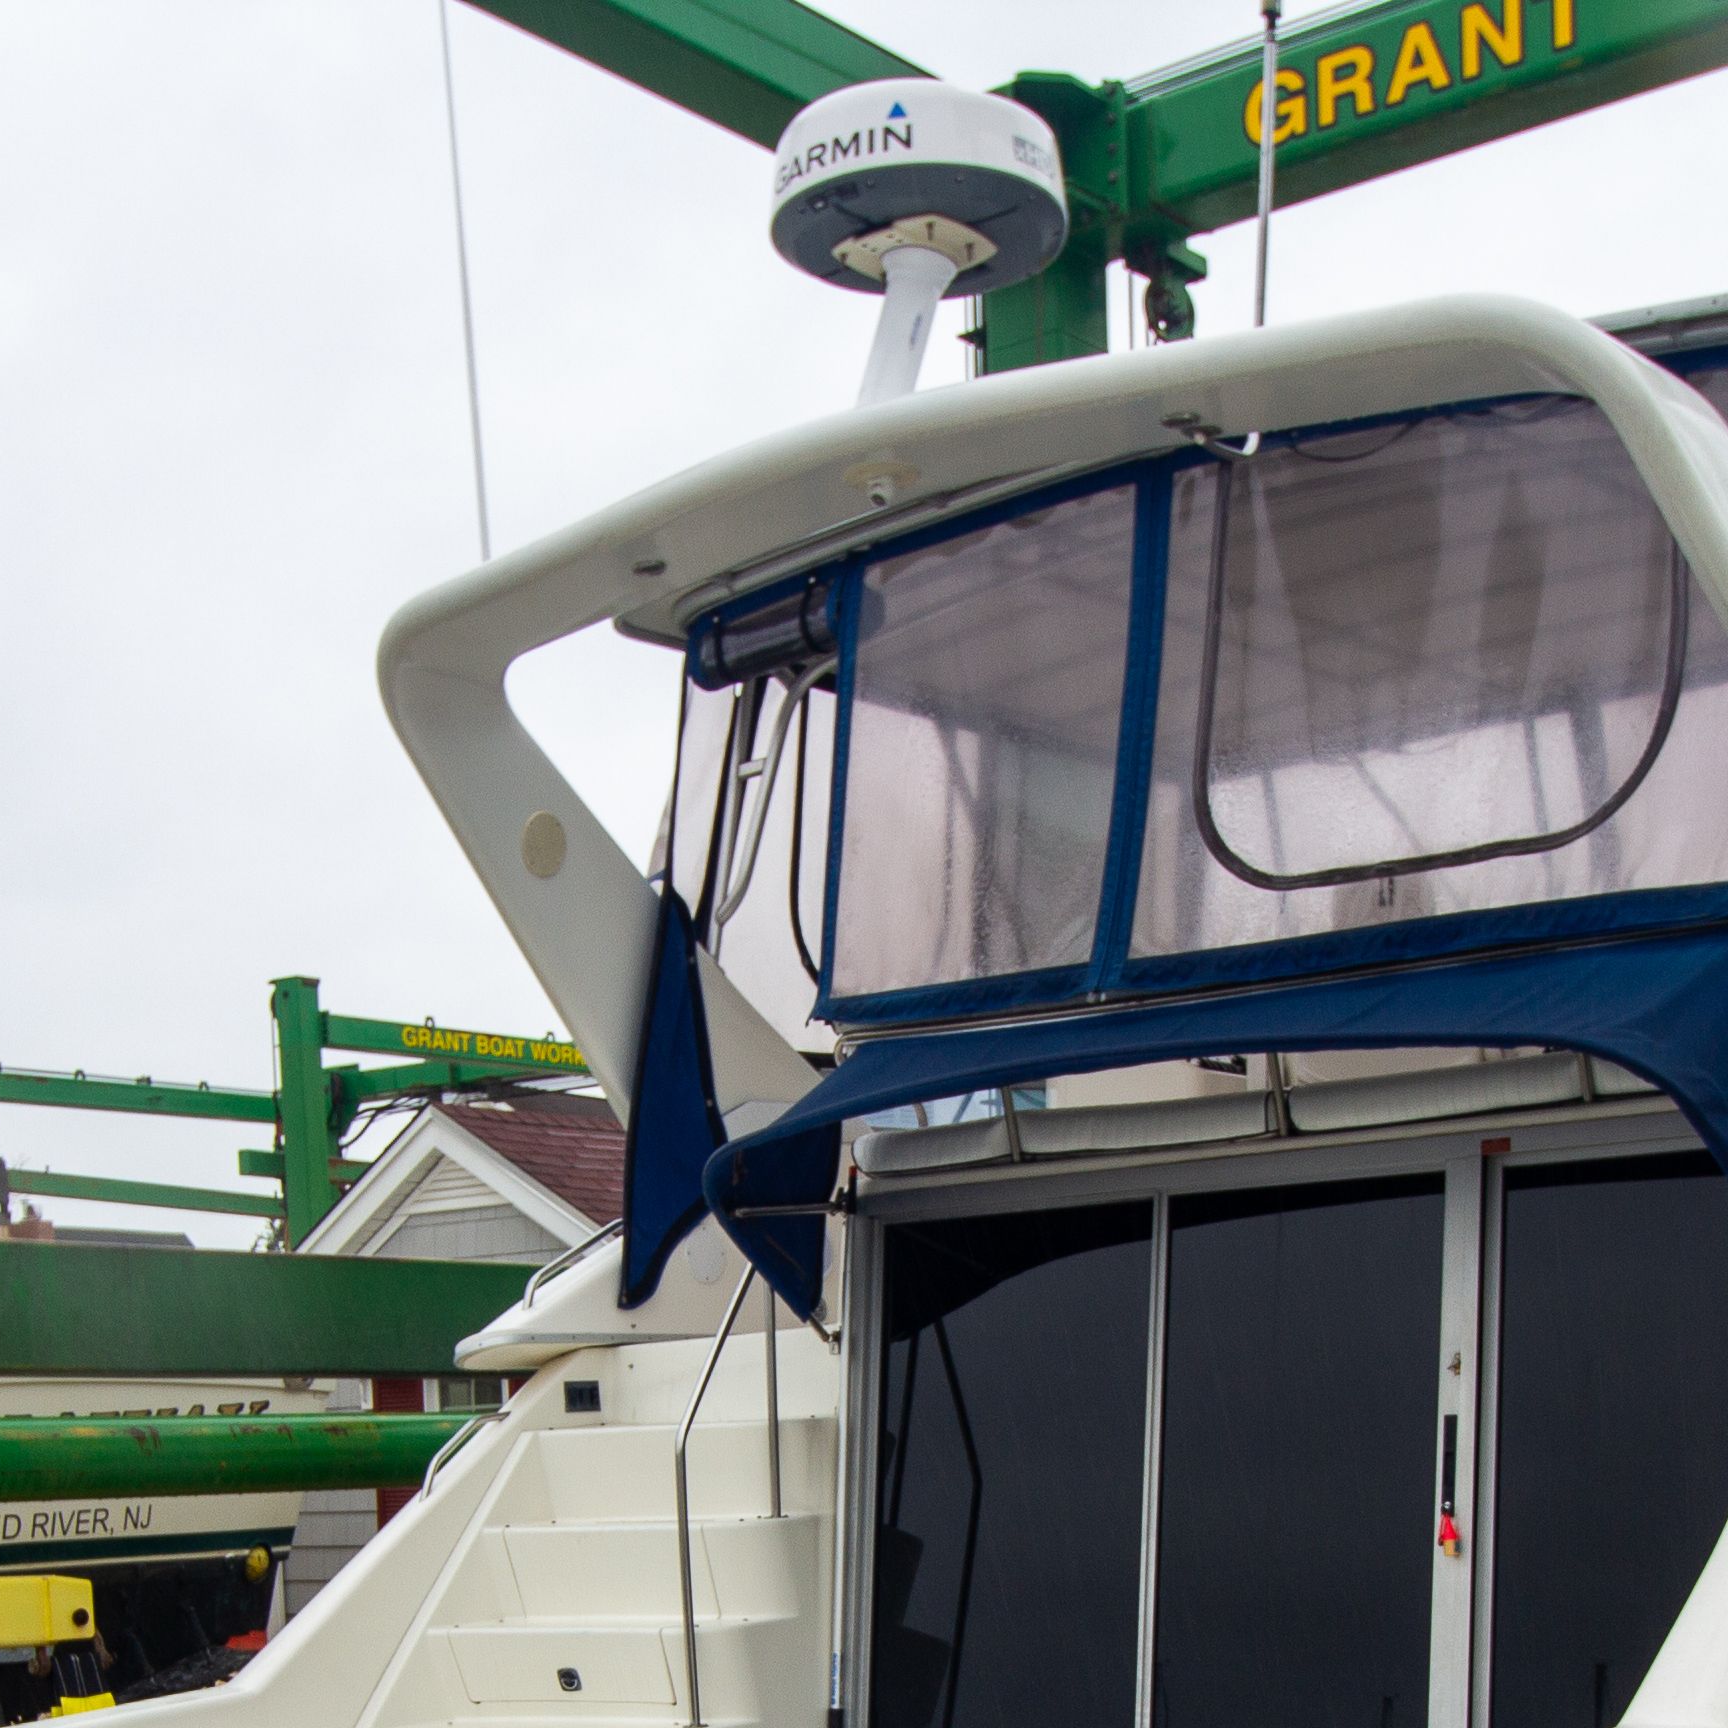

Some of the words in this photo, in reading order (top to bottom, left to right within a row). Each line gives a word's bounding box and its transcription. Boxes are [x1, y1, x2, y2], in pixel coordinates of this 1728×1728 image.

[1243, 0, 1574, 147] GRANT
[775, 123, 914, 194] GARMIN
[401, 1025, 471, 1053] GRANT
[475, 1034, 526, 1059] BOAT
[30, 1508, 115, 1538] RIVER,
[123, 1504, 153, 1531] NJ
